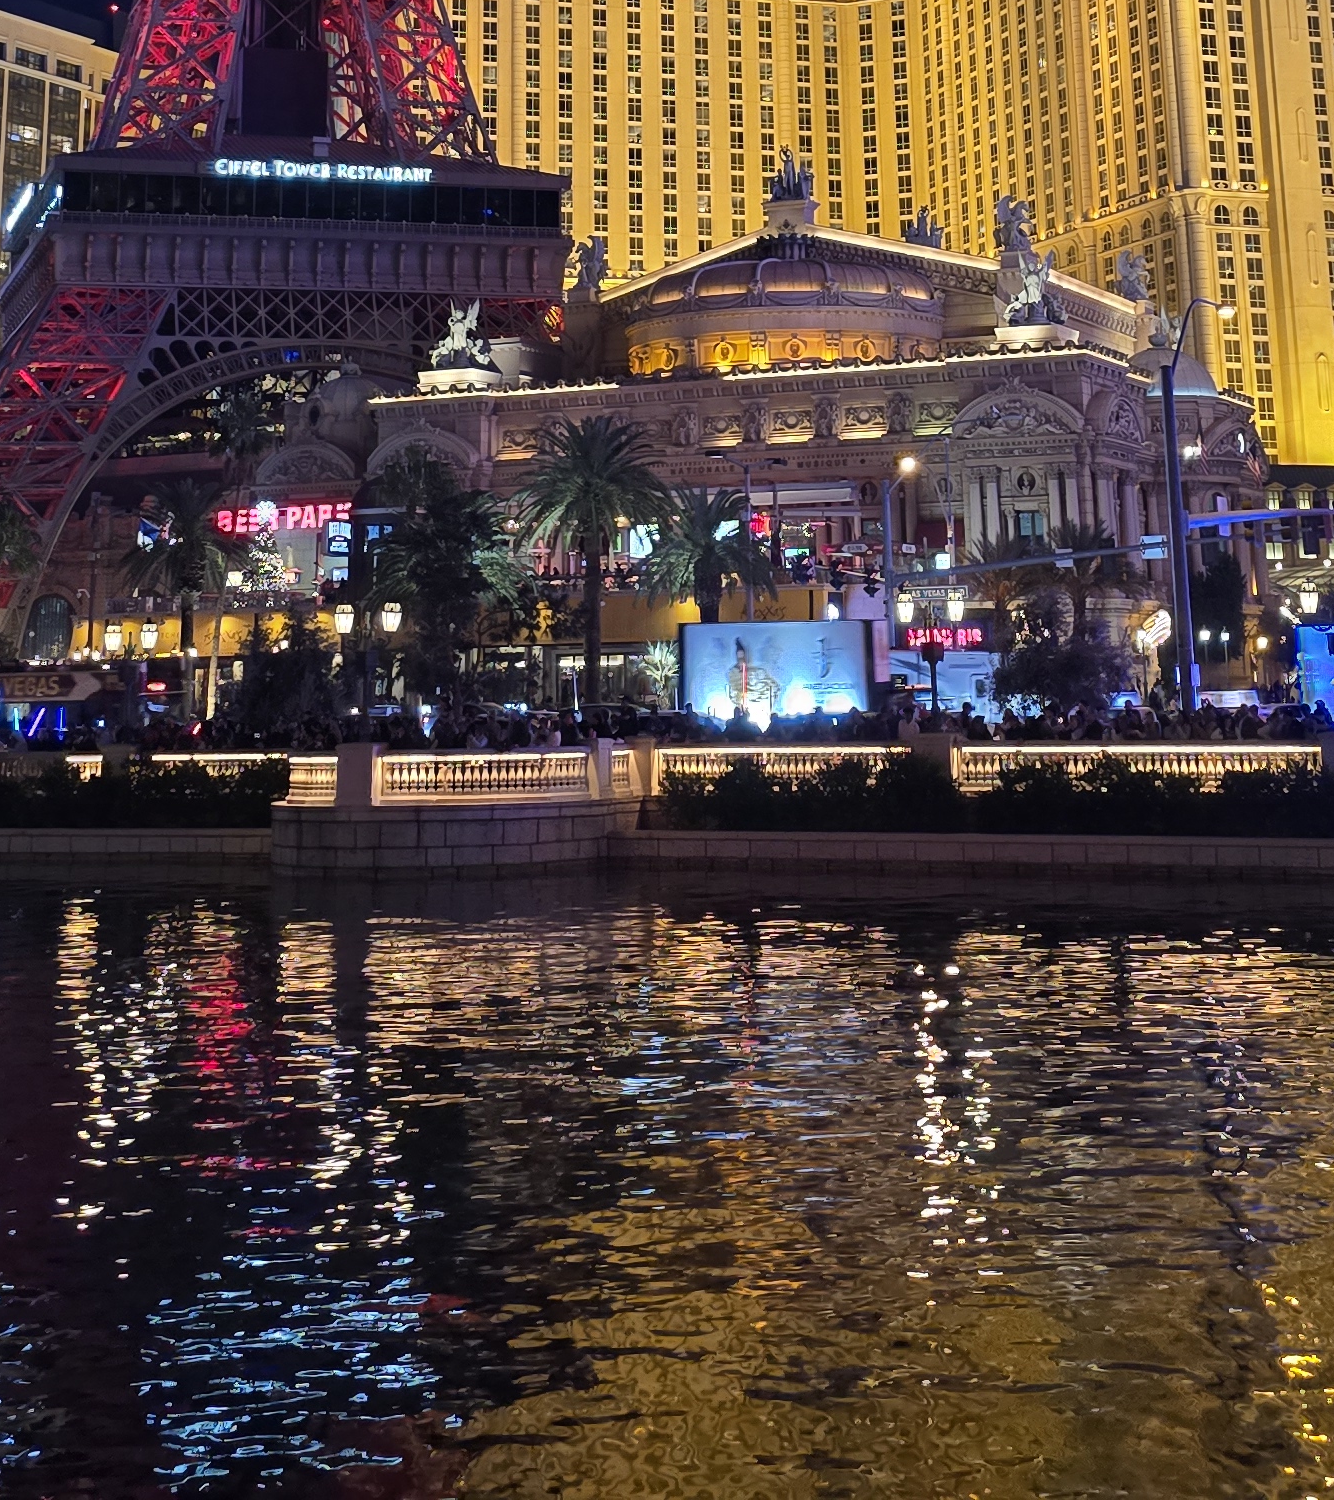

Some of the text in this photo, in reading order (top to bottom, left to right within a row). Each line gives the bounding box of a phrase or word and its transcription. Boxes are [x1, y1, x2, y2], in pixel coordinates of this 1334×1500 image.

[215, 159, 432, 182] EIFFEL TOWER RESTAURANT
[670, 465, 735, 475] NATIONALE
[797, 458, 848, 469] MUSIQUE
